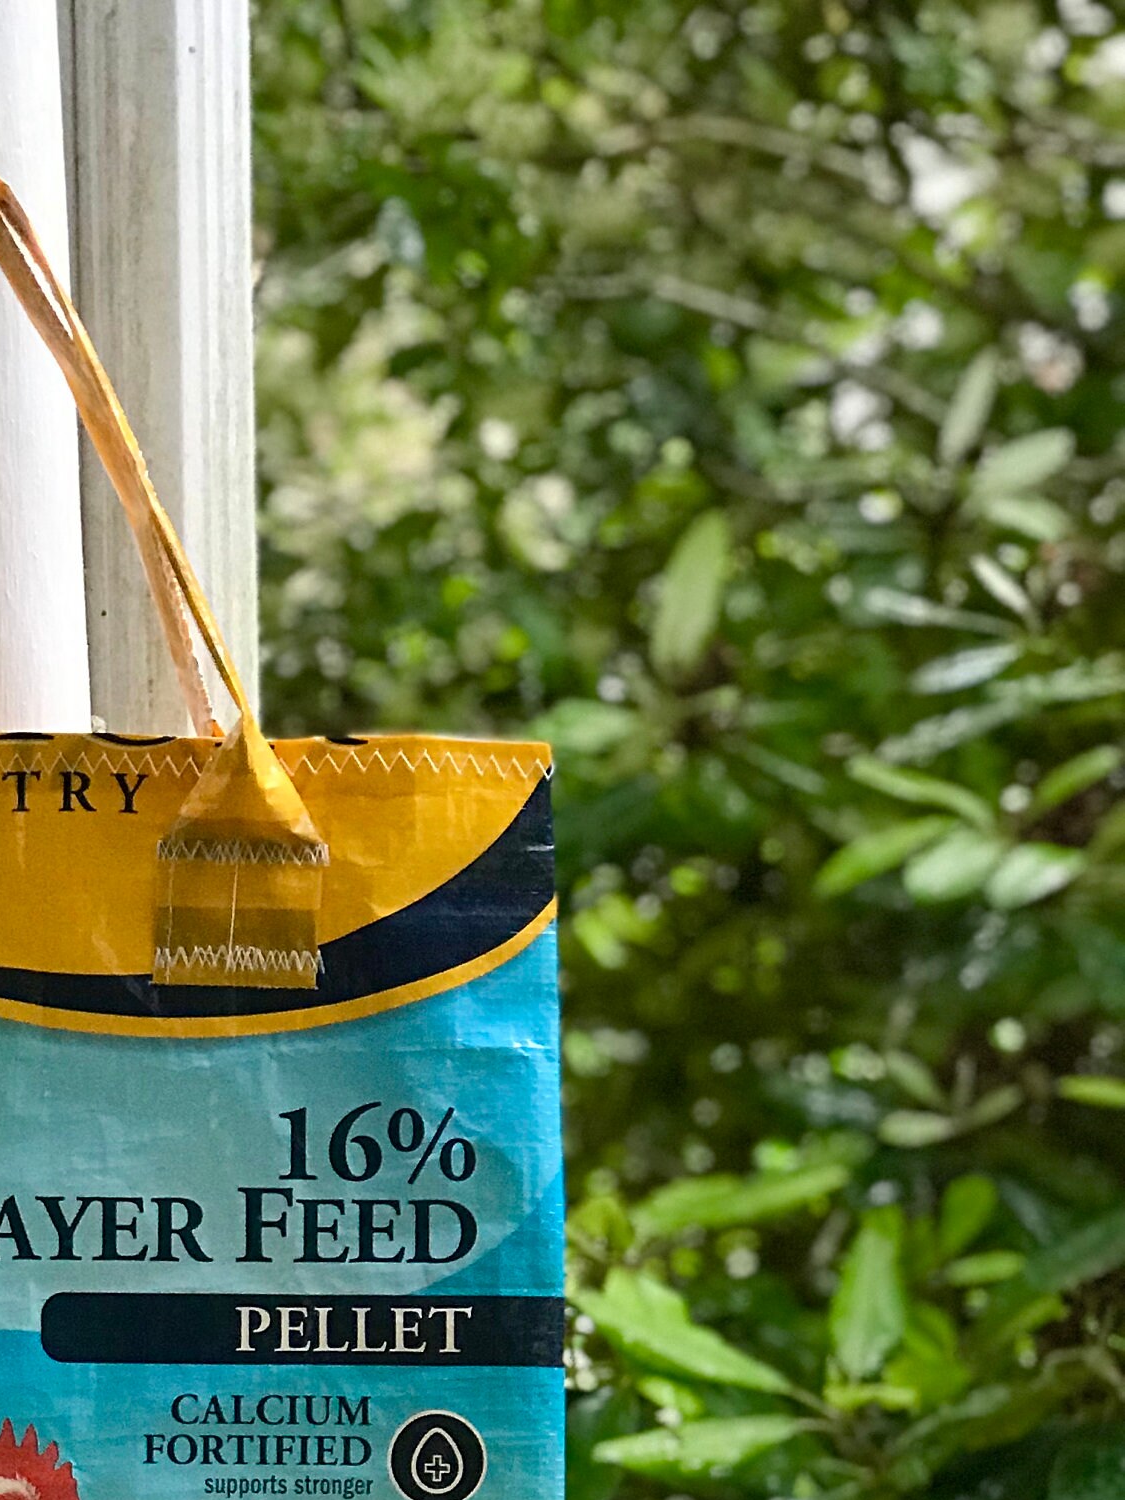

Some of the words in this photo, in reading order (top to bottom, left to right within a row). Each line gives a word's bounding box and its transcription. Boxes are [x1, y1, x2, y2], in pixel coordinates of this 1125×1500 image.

[278, 1101, 477, 1186] 16%
[235, 1186, 478, 1265] FEED
[234, 1305, 473, 1355] PELLET
[170, 1393, 373, 1426] CALCIUM
[142, 1433, 373, 1467] FORTIFIED
[204, 1475, 288, 1498] supports
[293, 1475, 374, 1500] stronger
